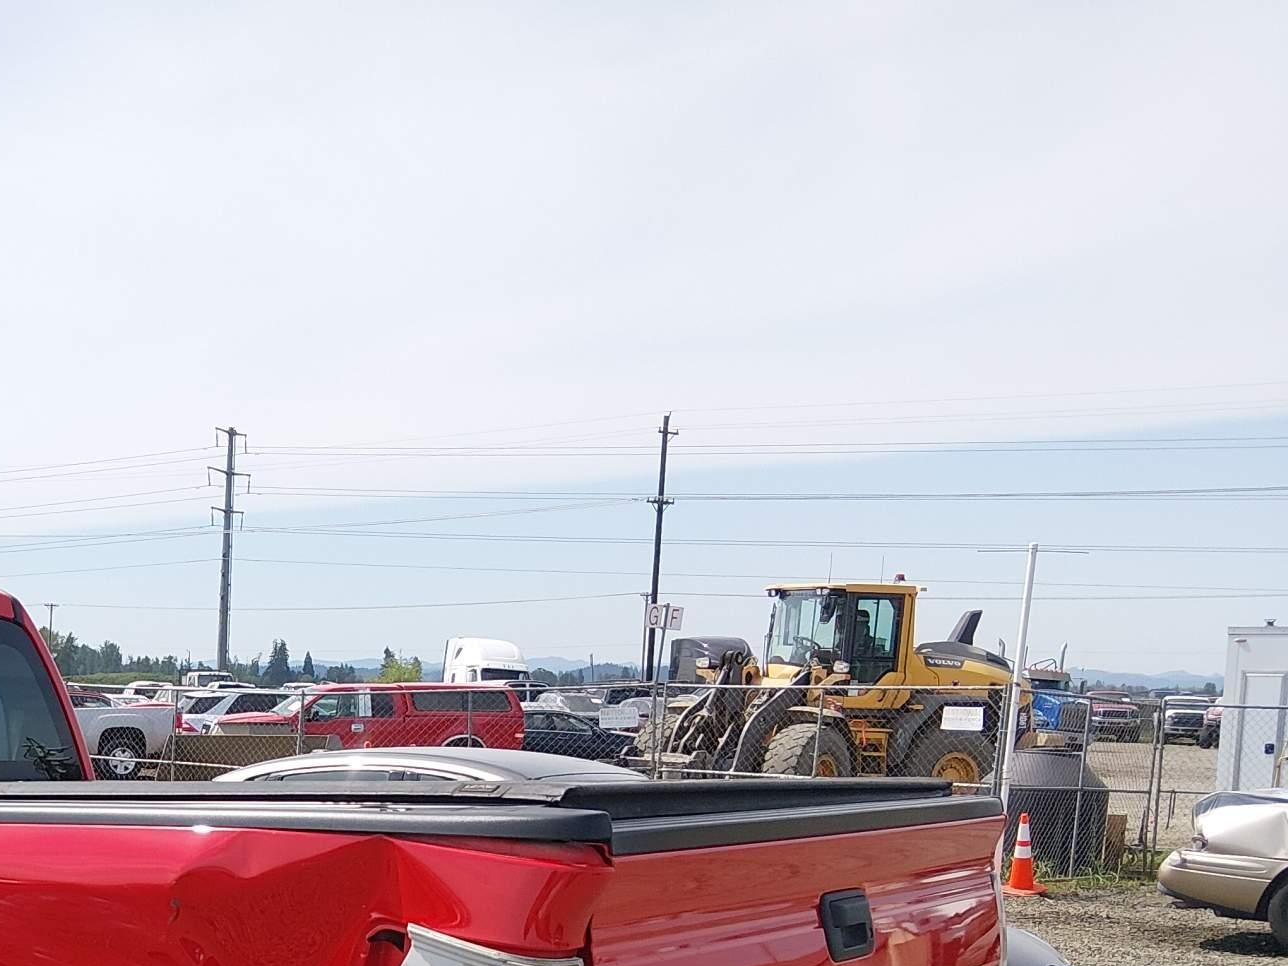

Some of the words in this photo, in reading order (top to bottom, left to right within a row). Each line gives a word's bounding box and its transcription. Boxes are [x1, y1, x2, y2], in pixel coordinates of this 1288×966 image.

[649, 606, 659, 626] G
[670, 608, 680, 628] F
[927, 658, 961, 667] VOLVO
